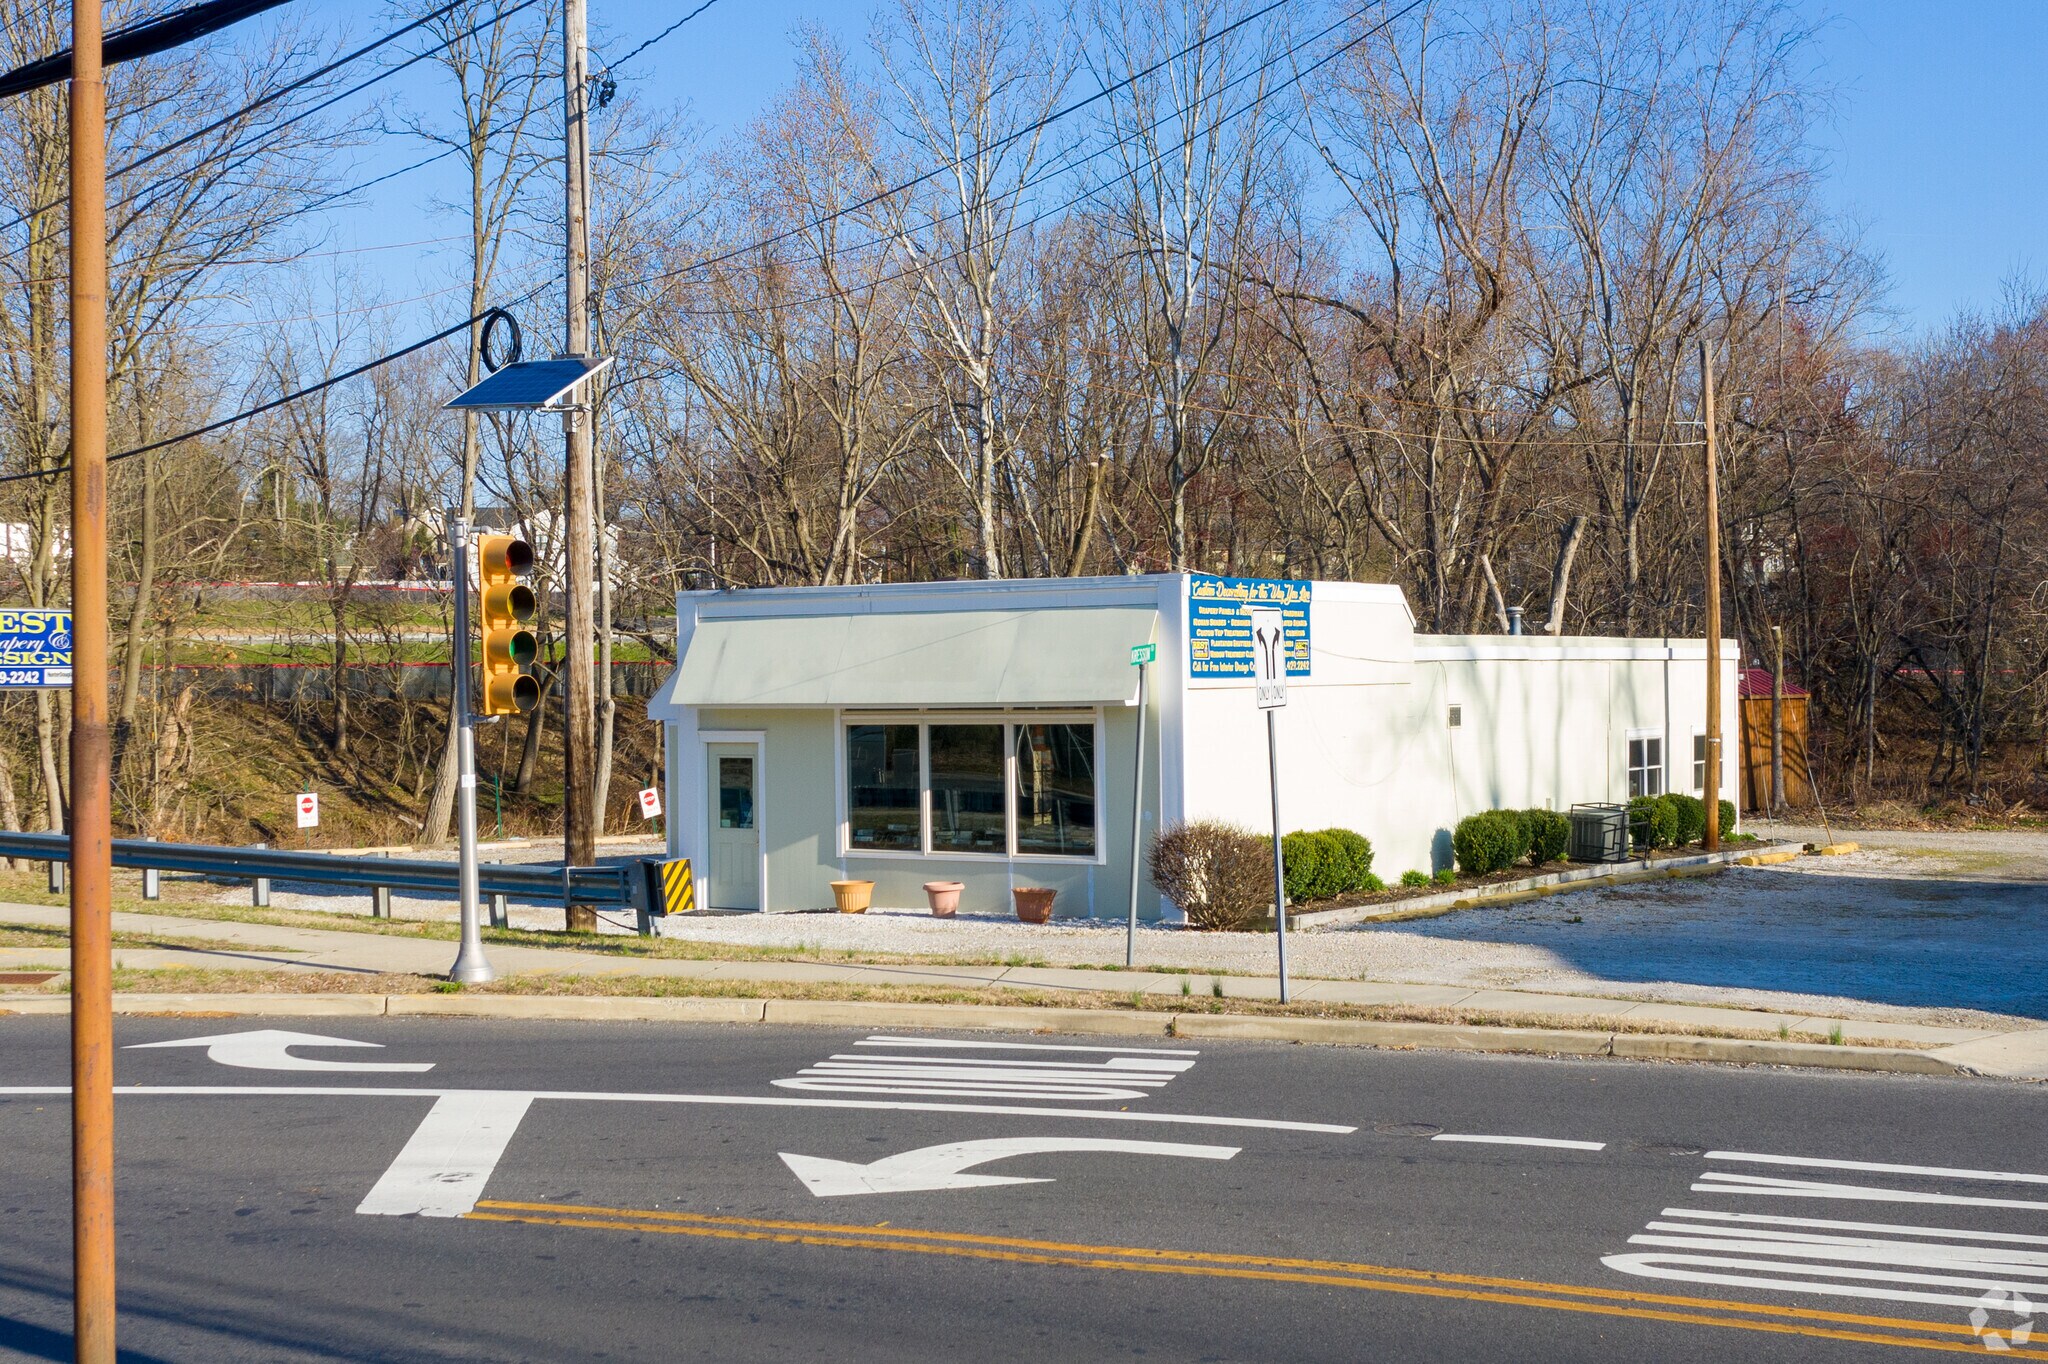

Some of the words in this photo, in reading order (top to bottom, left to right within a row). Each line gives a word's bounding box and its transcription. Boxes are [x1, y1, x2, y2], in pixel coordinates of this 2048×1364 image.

[1192, 581, 1215, 596] Custom
[1216, 581, 1248, 604] Decorating
[1248, 582, 1258, 602] for
[1257, 583, 1268, 599] the
[1268, 583, 1284, 604] Way
[1284, 583, 1298, 605] You
[1258, 686, 1271, 701] ONLY
[1272, 684, 1285, 699] ONLY
